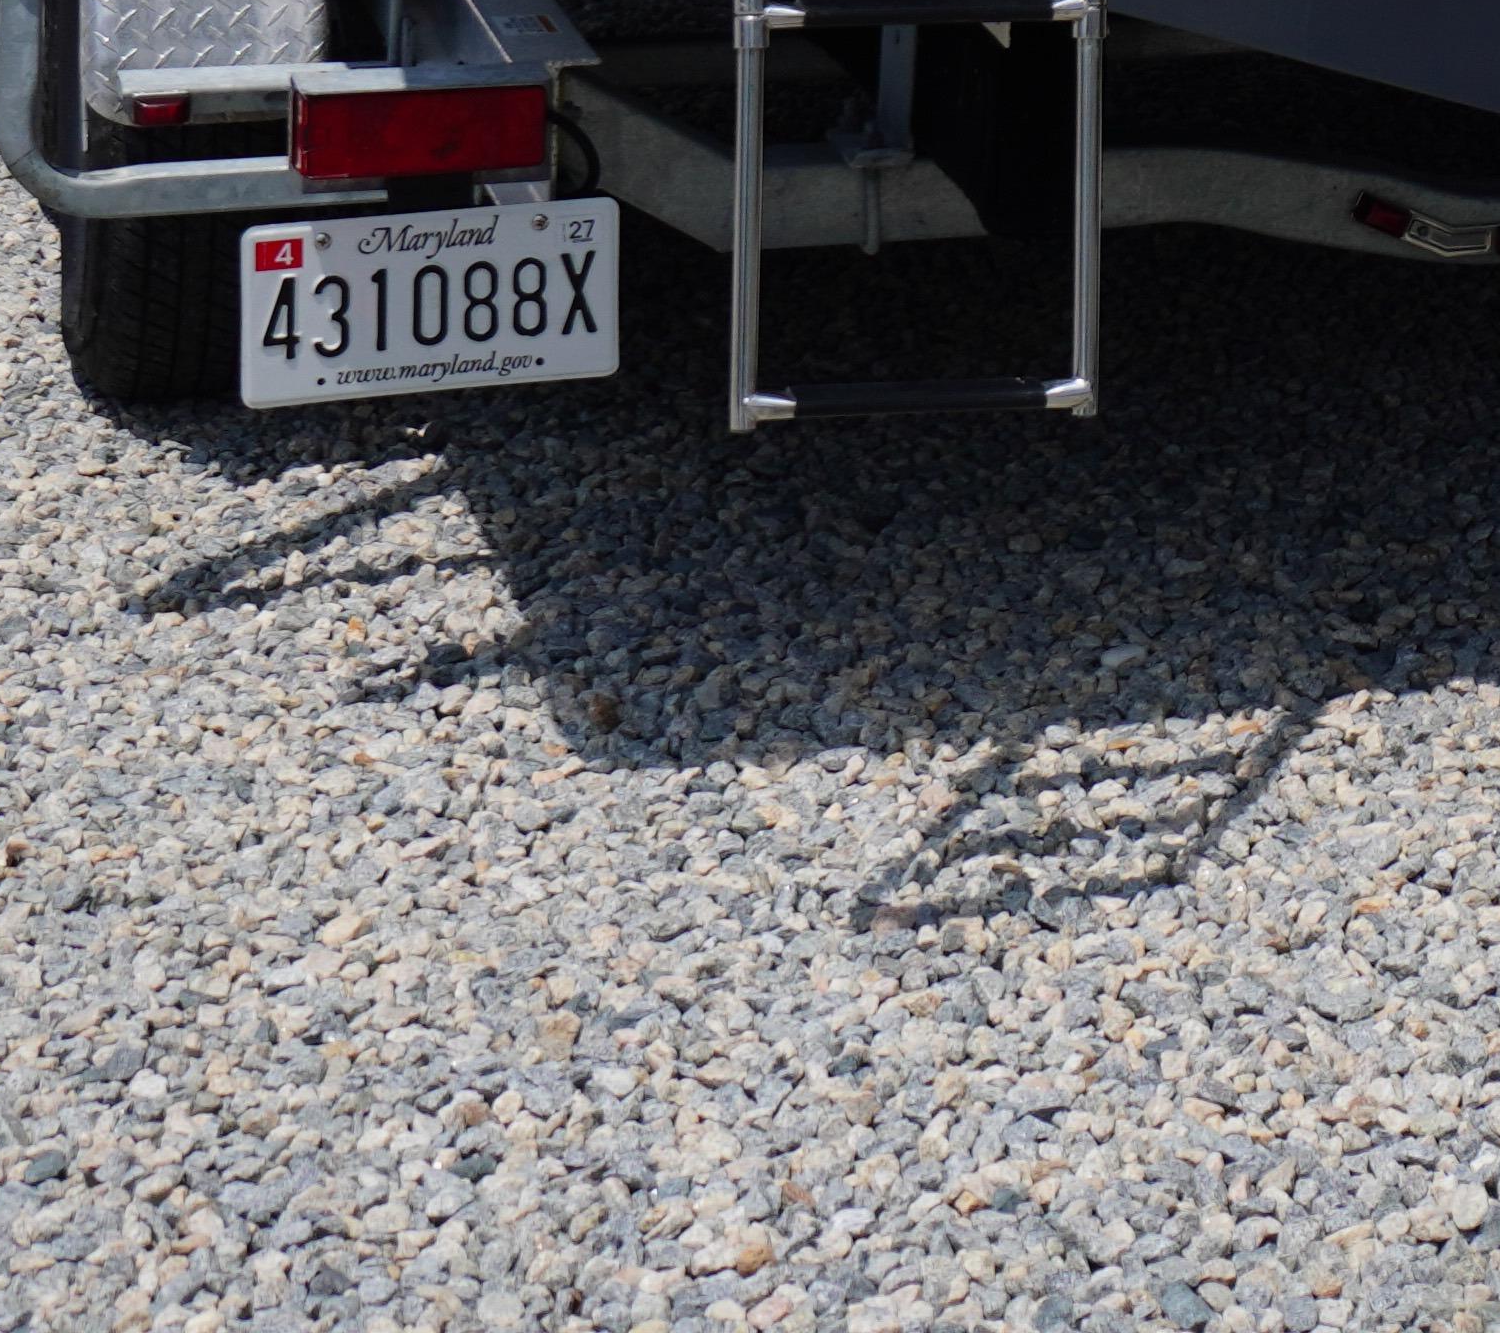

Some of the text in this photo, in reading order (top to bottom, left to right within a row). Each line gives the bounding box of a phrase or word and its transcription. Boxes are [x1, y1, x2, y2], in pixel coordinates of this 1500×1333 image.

[357, 214, 500, 259] Maryland
[569, 220, 596, 240] 27
[274, 242, 294, 265] 4
[262, 249, 599, 360] 431088X
[336, 352, 533, 386] www.maryland.gov
